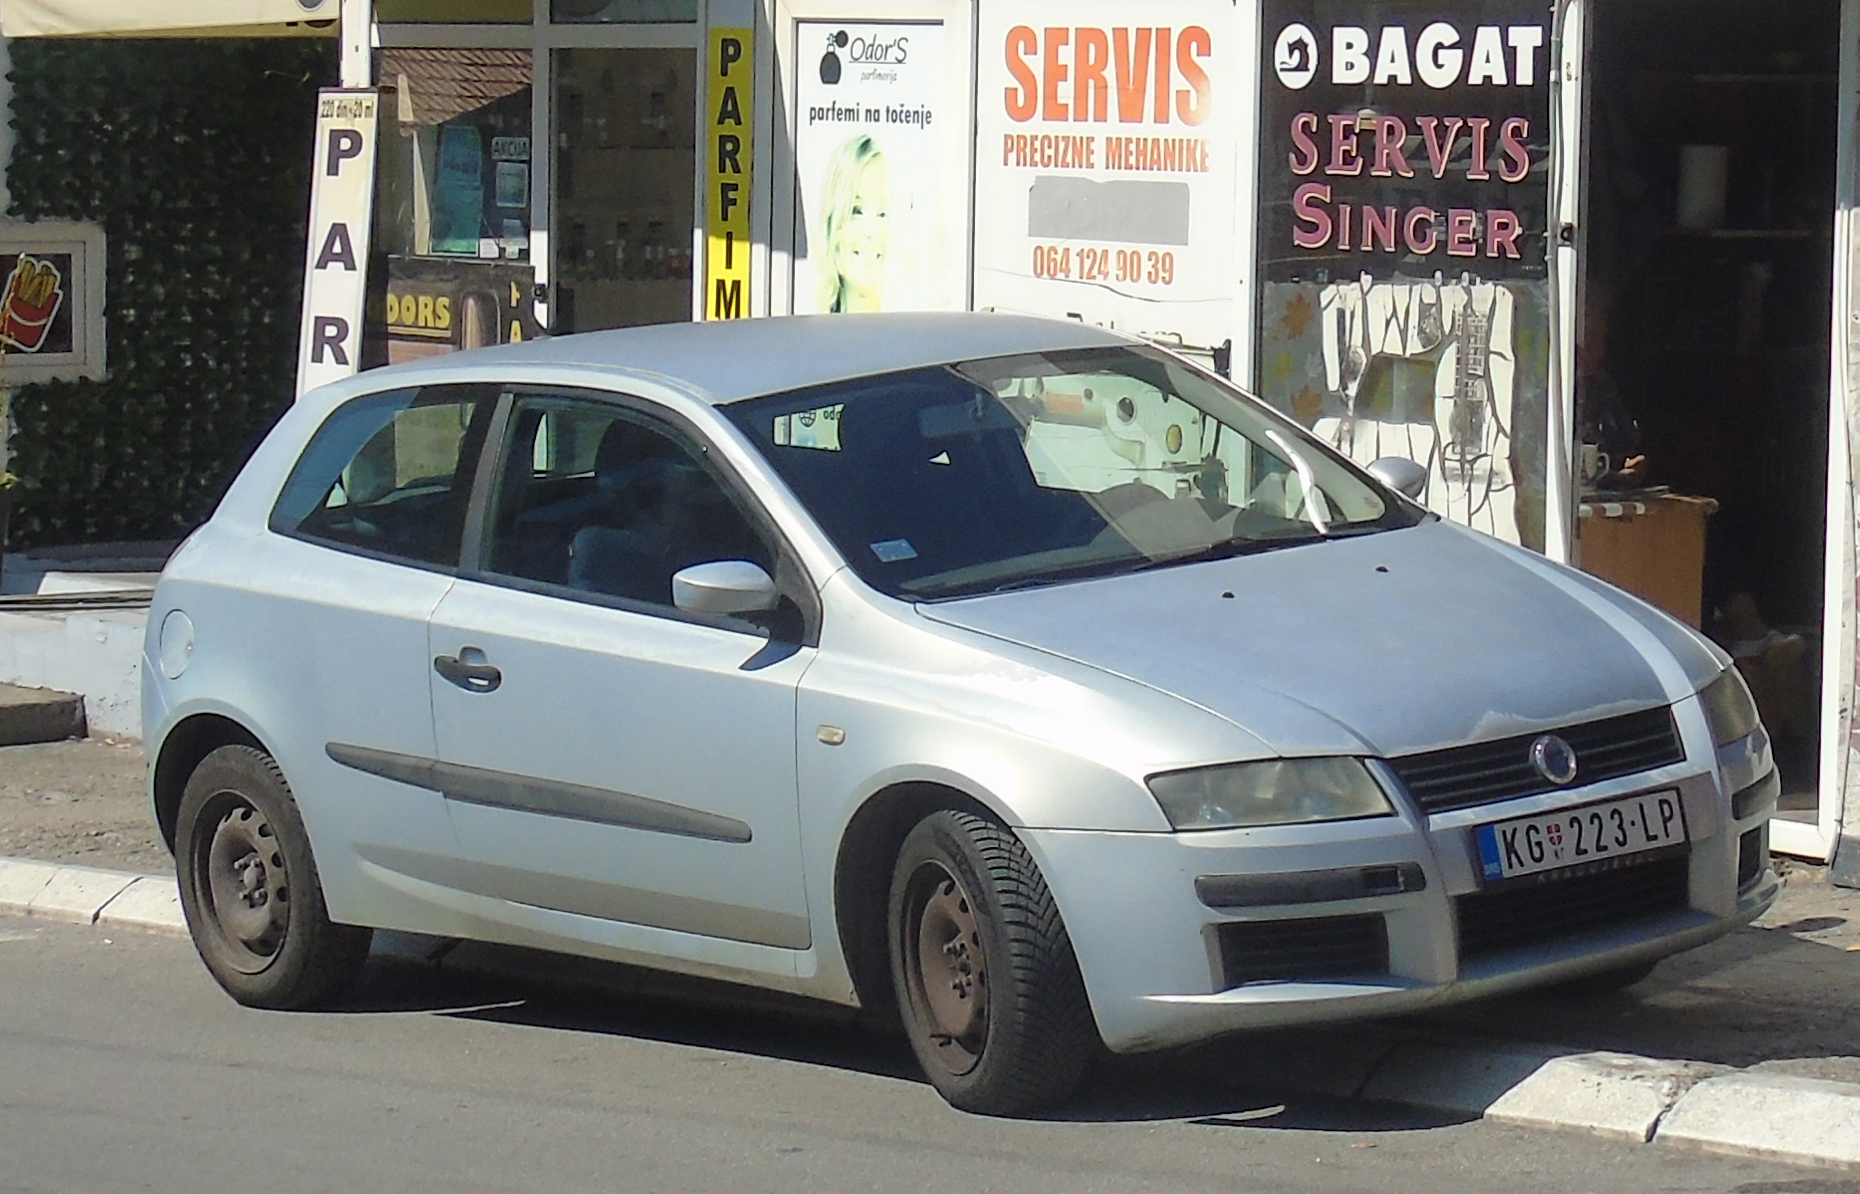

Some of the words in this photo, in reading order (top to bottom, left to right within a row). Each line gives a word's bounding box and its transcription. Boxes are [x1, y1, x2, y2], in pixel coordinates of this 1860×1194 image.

[850, 34, 909, 63] Odor'S
[1004, 25, 1212, 126] SERVIS
[1332, 22, 1543, 88] BAGAT
[809, 100, 860, 126] parfemi
[865, 108, 881, 123] na
[885, 103, 932, 130] točenje
[1289, 111, 1530, 182] SERVIS
[715, 38, 742, 319] PARFIM
[1003, 133, 1095, 169] PRECIZNE
[1105, 136, 1210, 172] MEHANIKE
[310, 129, 364, 366] PAR
[1293, 182, 1521, 259] SINGER
[1033, 245, 1071, 279] 064
[1076, 247, 1110, 280] 124
[1116, 249, 1142, 284] 90
[1147, 251, 1174, 285] 39
[1502, 824, 1545, 870] KG
